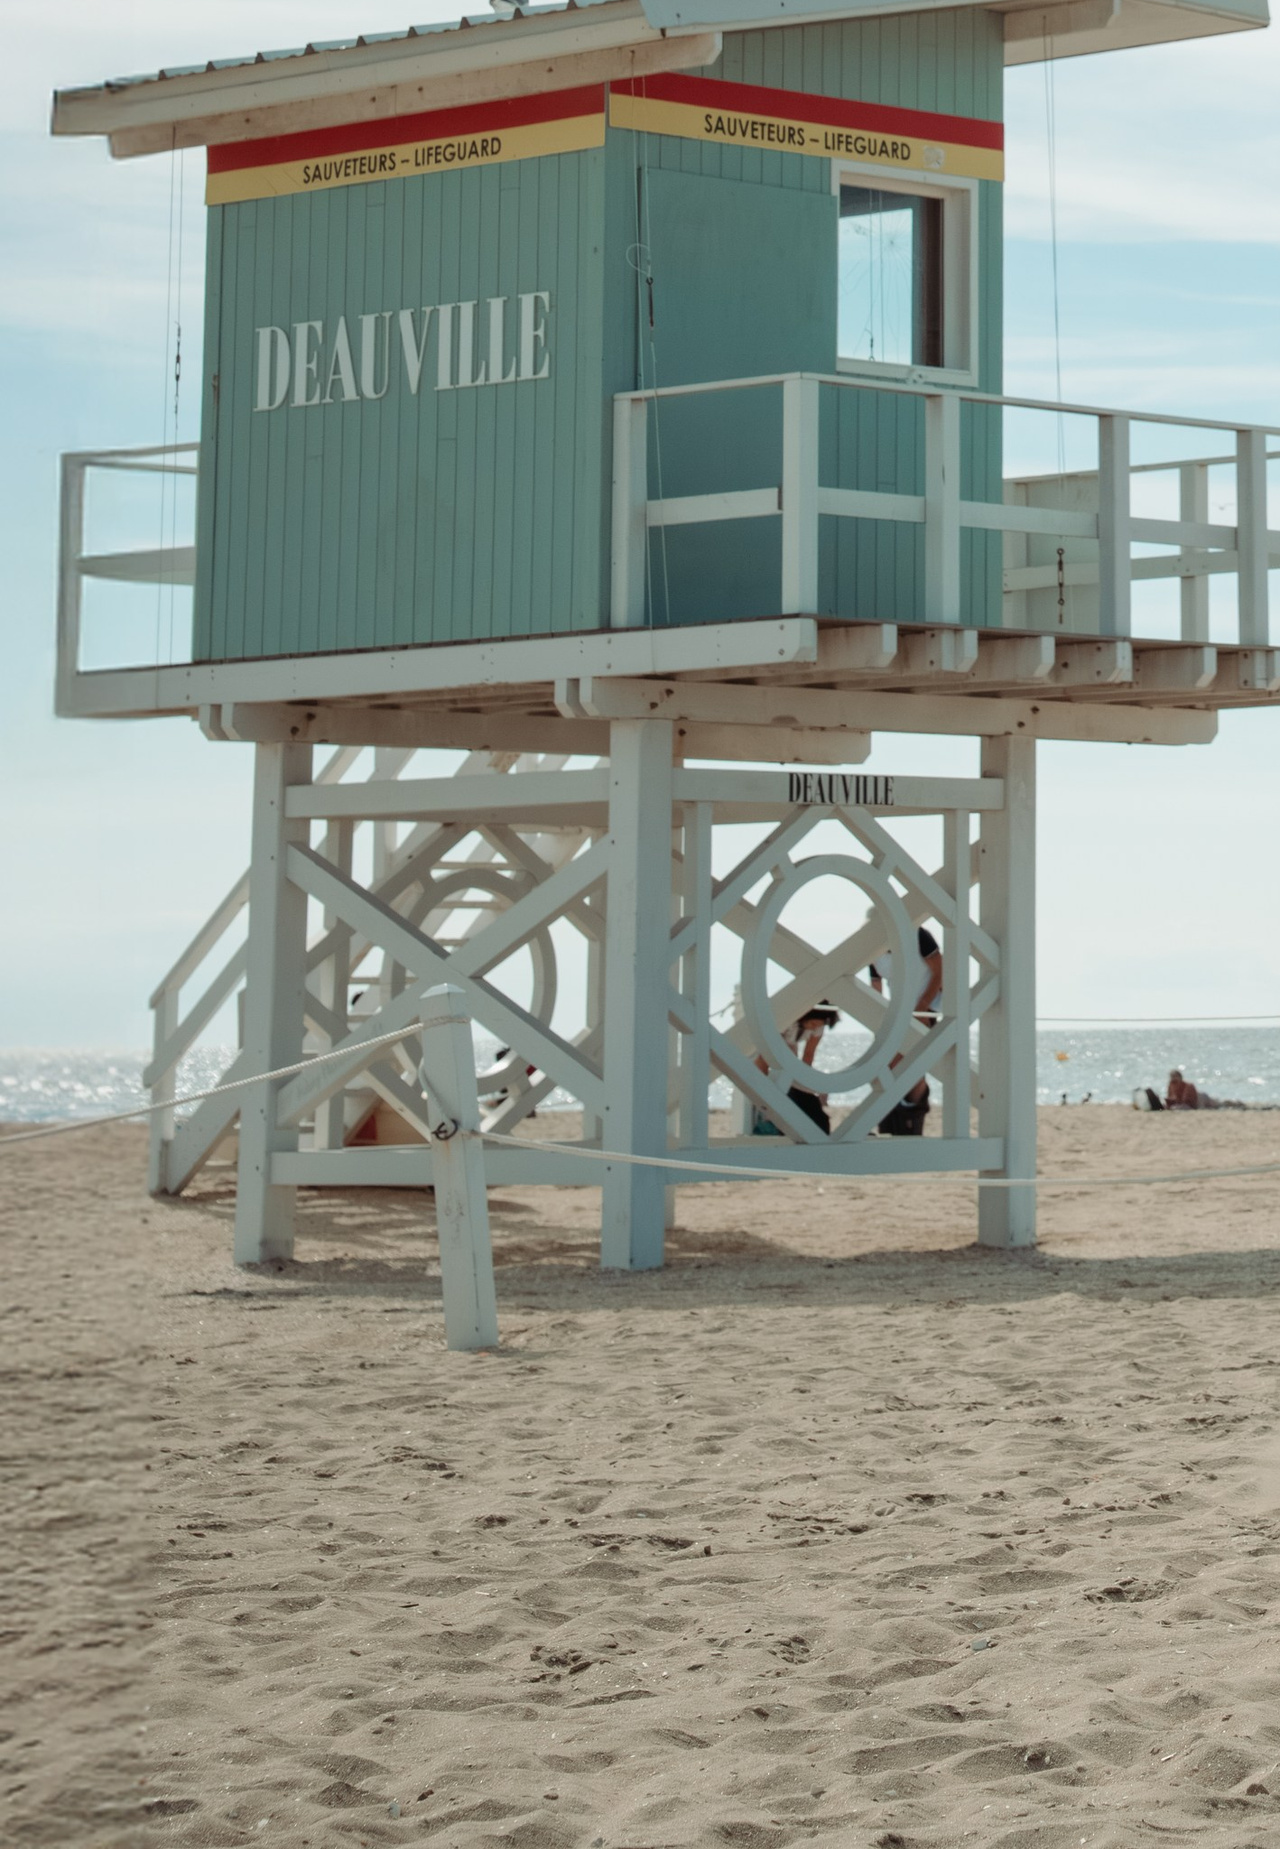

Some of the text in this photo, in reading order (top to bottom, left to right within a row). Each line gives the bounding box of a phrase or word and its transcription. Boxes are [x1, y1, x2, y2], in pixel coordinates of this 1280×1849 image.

[303, 152, 396, 184] SAUVETEURS
[414, 137, 502, 167] LIFEGUARD
[704, 114, 805, 146] SAUVETEURS
[824, 131, 911, 161] LIFEGUARD
[253, 291, 550, 413] DEAUVILLE
[789, 773, 894, 806] DEAUVILLE
